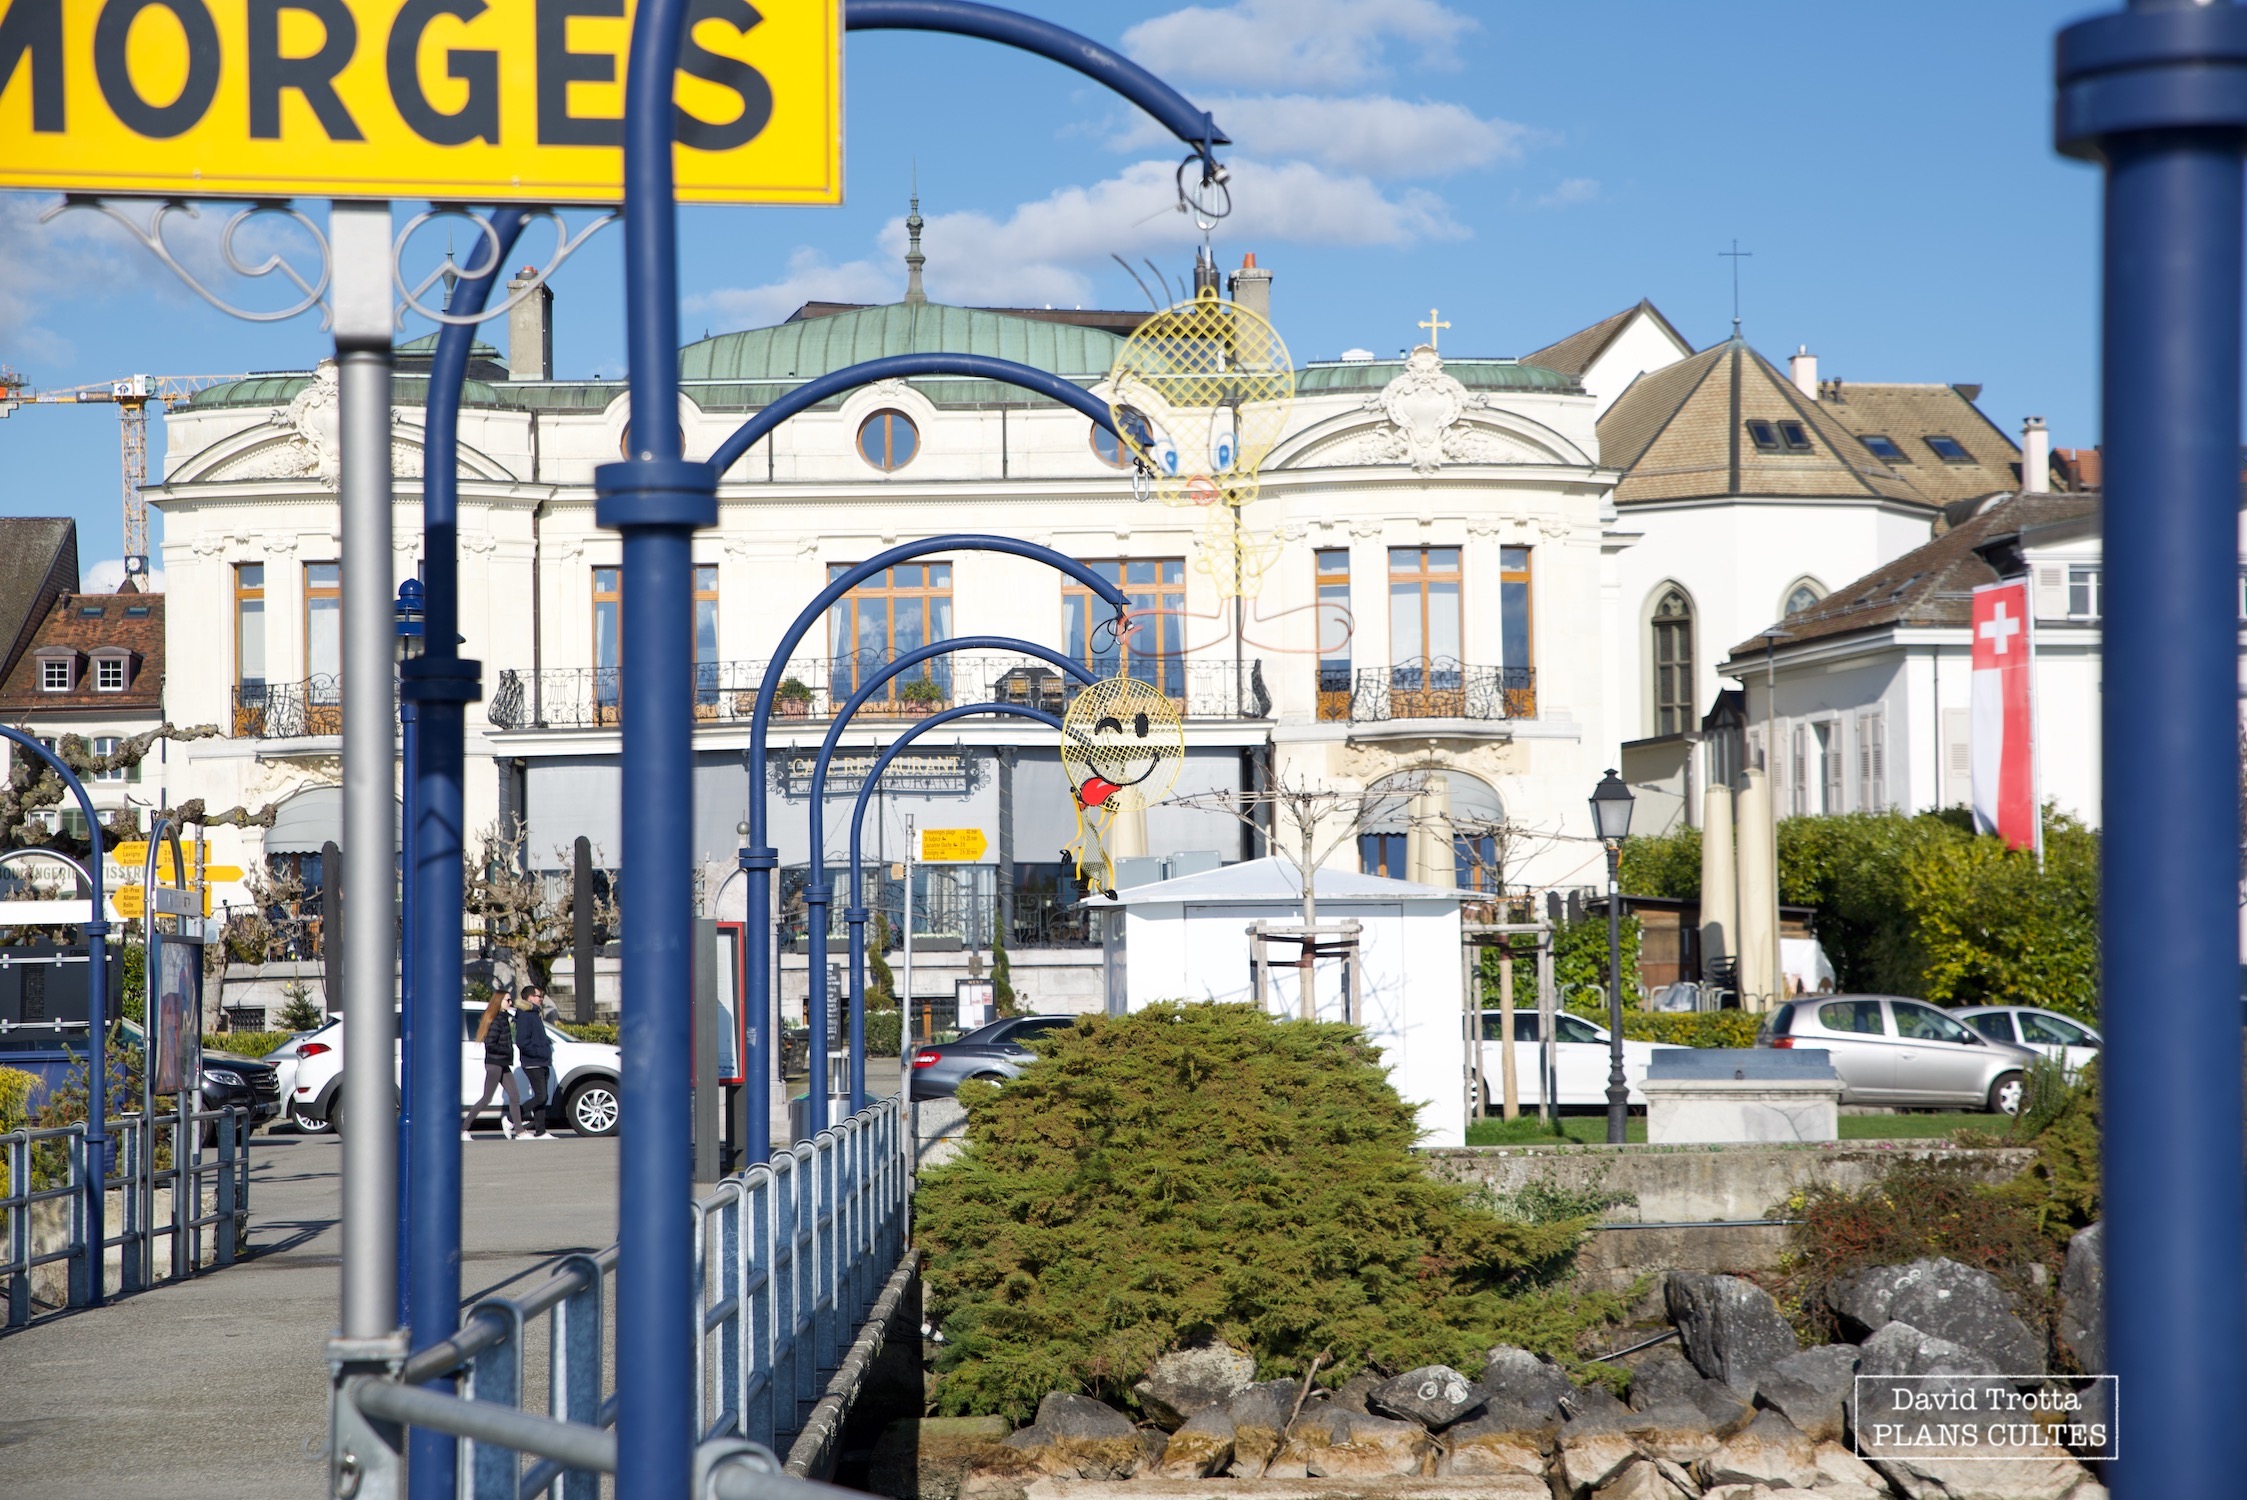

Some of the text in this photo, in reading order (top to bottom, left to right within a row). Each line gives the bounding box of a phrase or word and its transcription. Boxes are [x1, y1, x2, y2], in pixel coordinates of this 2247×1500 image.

[792, 755, 961, 777] CAÉ RESAURANT
[123, 851, 140, 859] Lavigny
[0, 866, 77, 880] OUNGERIE
